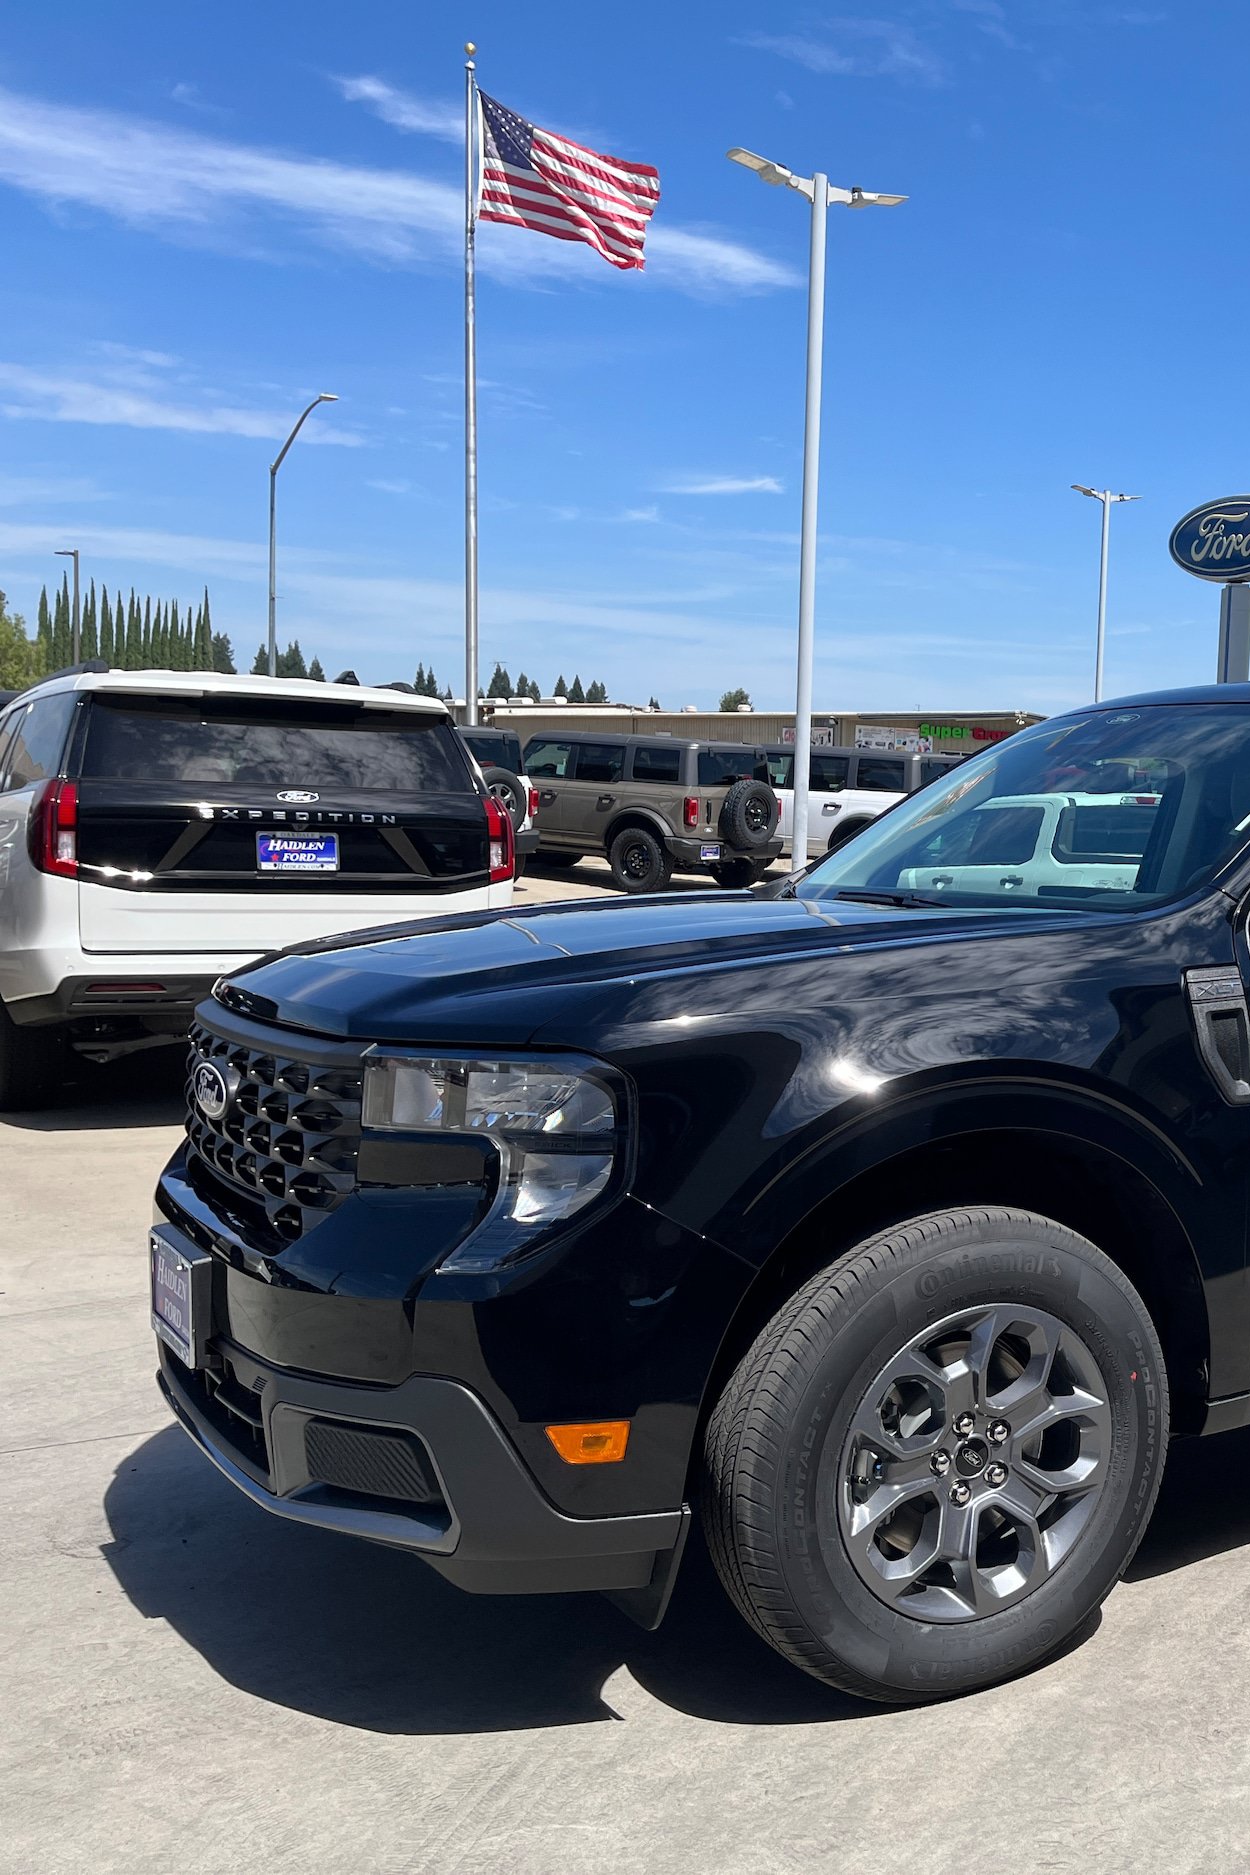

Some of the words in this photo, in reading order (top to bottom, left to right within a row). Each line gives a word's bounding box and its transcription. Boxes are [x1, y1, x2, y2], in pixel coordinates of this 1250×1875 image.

[920, 723, 969, 740] Super
[200, 808, 396, 824] EXPEDITION
[268, 839, 325, 851] HAIDLEN
[282, 852, 316, 862] FORD
[1197, 982, 1241, 997] XLT
[198, 1068, 219, 1108] Ford
[157, 1255, 187, 1301] HAIDLEN
[917, 1250, 1047, 1299] Continental
[164, 1297, 182, 1329] FORD
